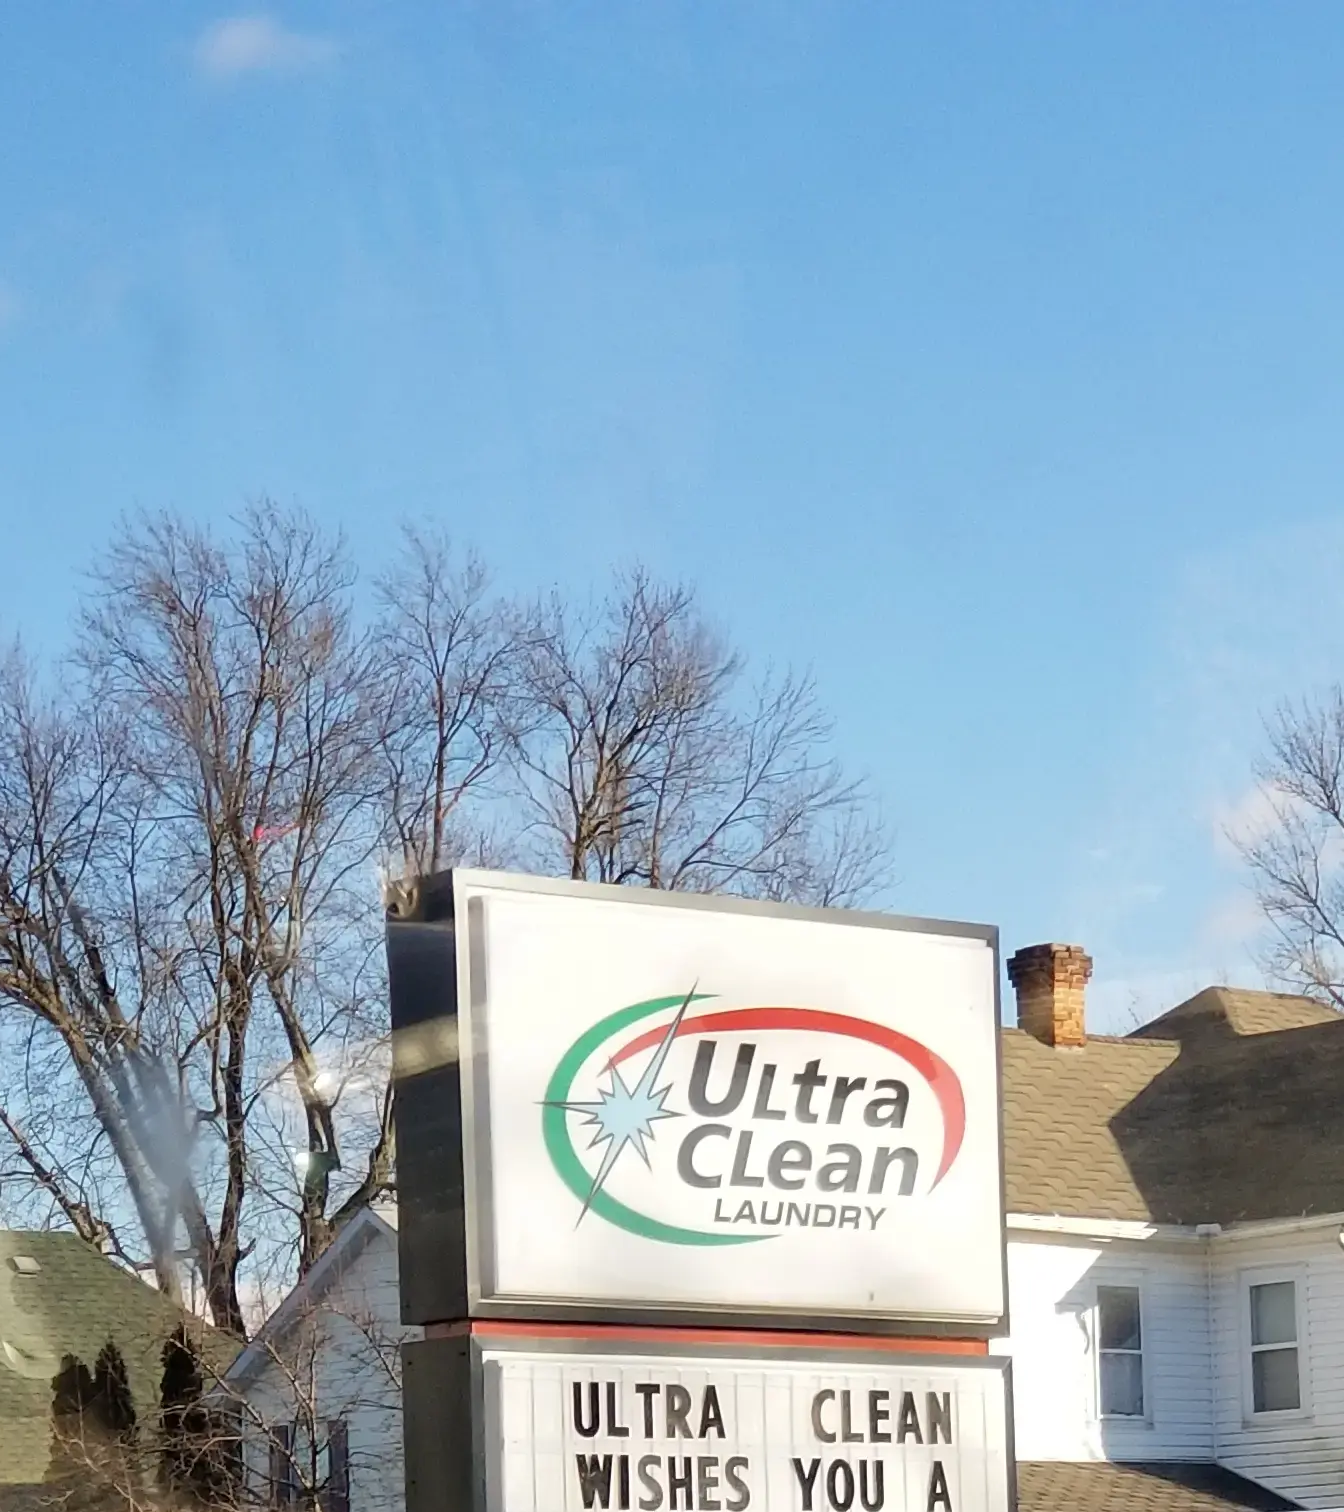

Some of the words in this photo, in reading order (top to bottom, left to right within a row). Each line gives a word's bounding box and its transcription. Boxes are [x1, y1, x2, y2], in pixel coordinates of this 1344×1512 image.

[714, 1198, 886, 1231] LAUNDRY
[572, 1381, 726, 1440] ULTRA
[811, 1389, 953, 1445] CLEAN
[576, 1454, 751, 1512] WISHES
[926, 1460, 953, 1512] A
